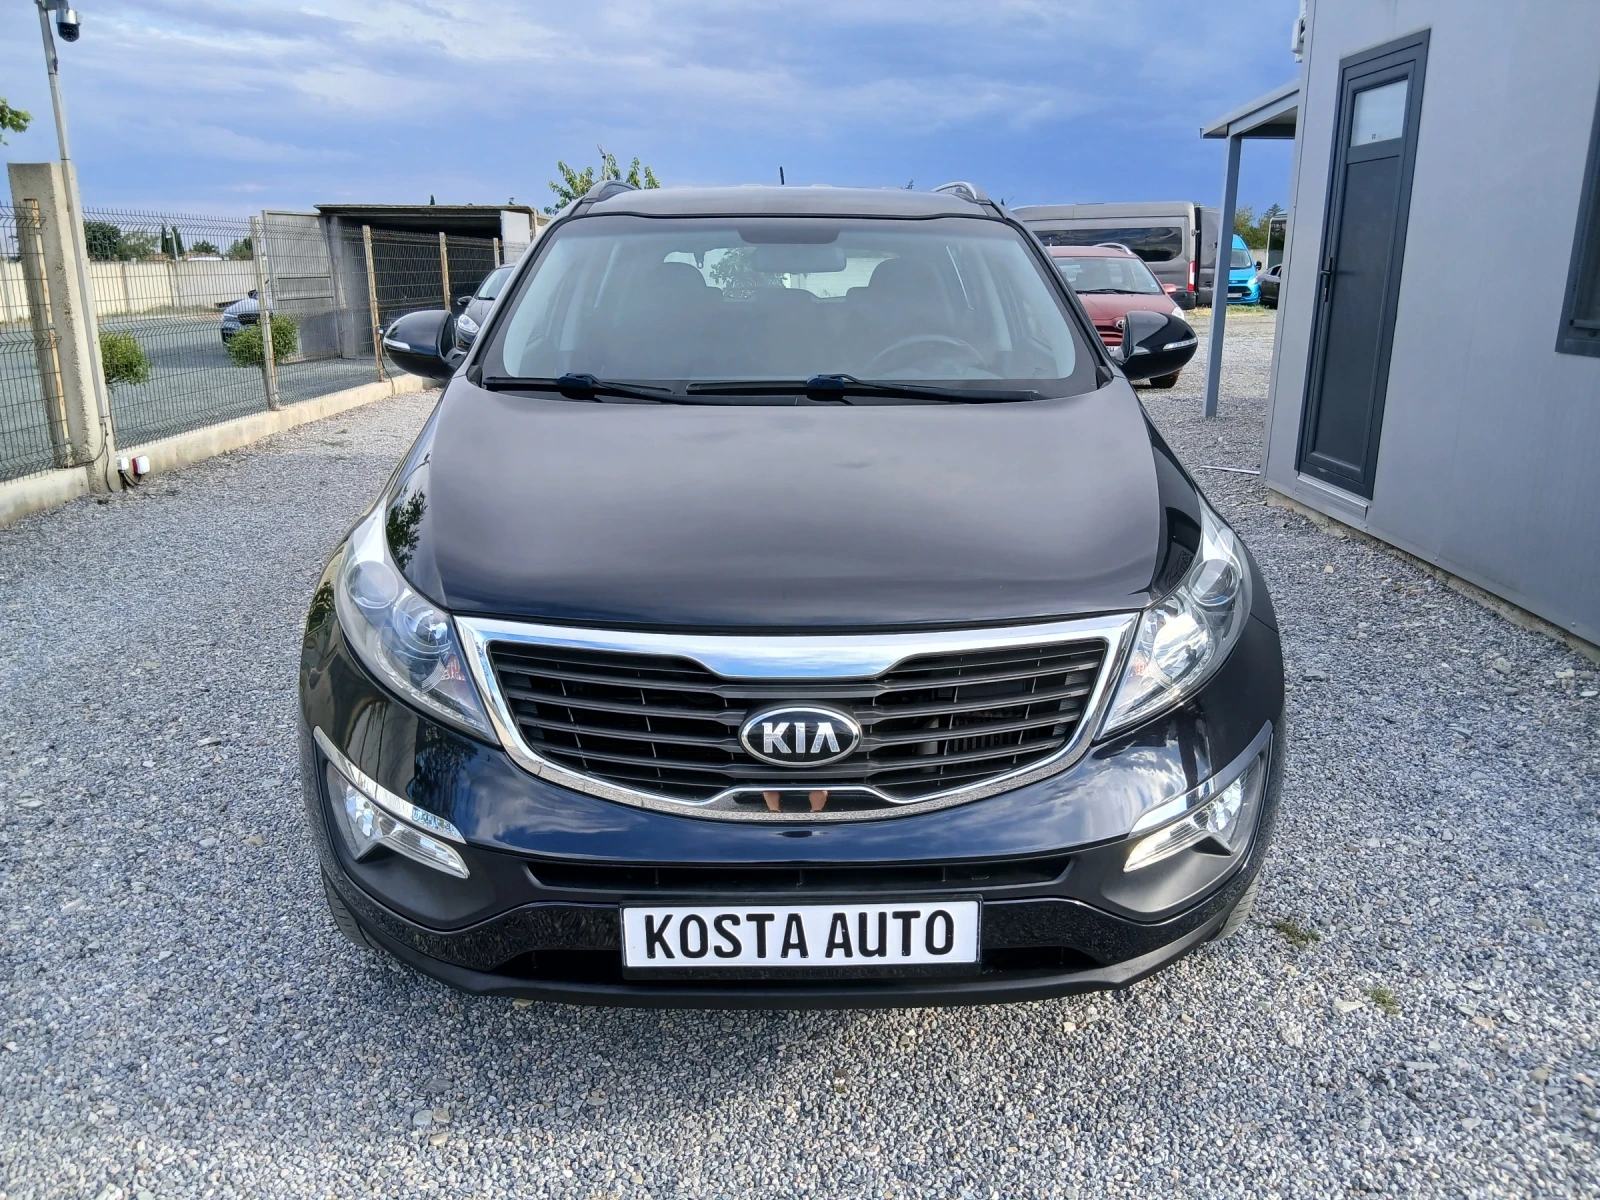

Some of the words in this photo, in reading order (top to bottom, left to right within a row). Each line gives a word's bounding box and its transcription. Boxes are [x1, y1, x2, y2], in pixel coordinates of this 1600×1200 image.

[762, 722, 840, 753] KIA
[645, 913, 808, 959] KOSTA
[825, 909, 955, 958] AUTO
